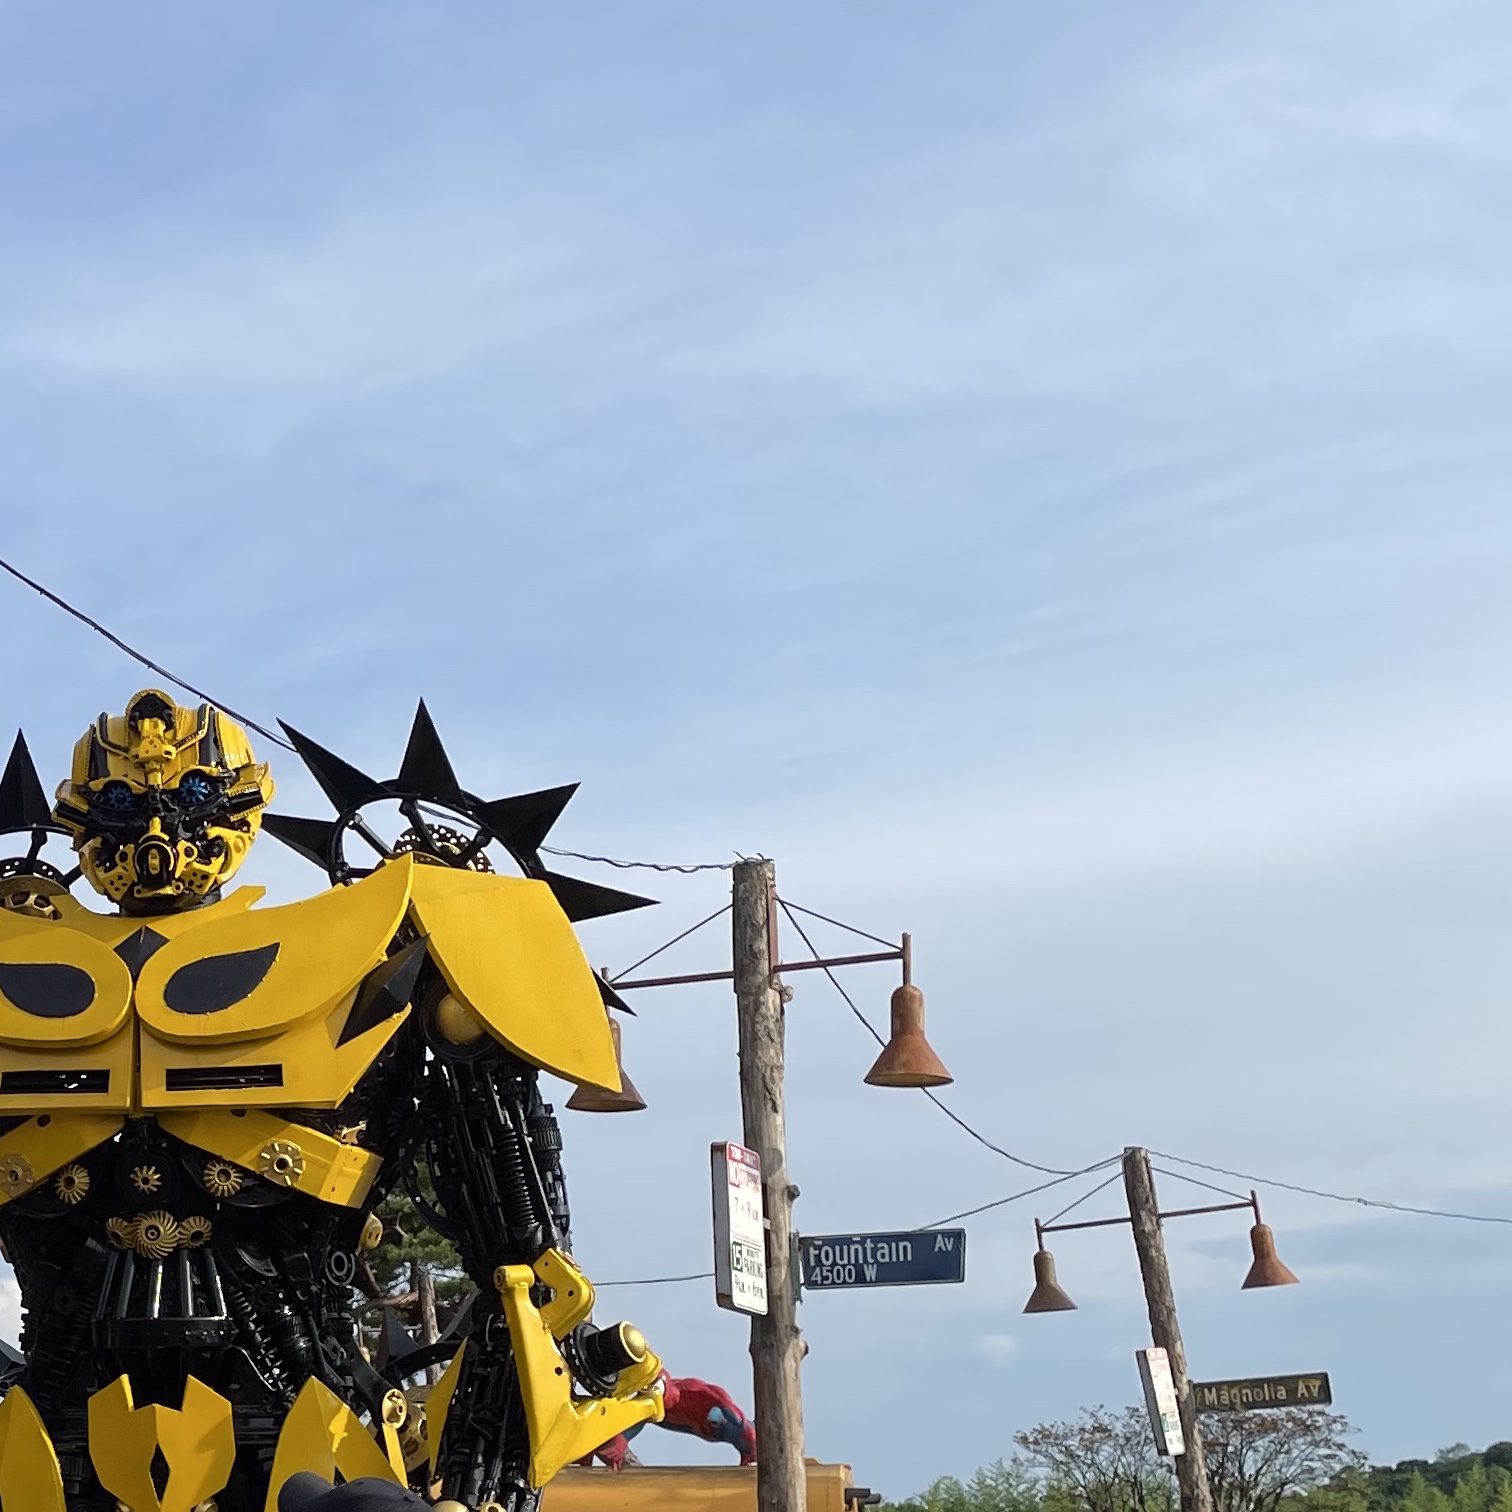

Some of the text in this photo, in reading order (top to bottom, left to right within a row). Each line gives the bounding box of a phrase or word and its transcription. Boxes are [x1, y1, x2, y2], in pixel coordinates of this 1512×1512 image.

[808, 1238, 912, 1266] Fountain
[810, 1264, 878, 1285] 4500 W
[1204, 1385, 1287, 1409] Magnolia
